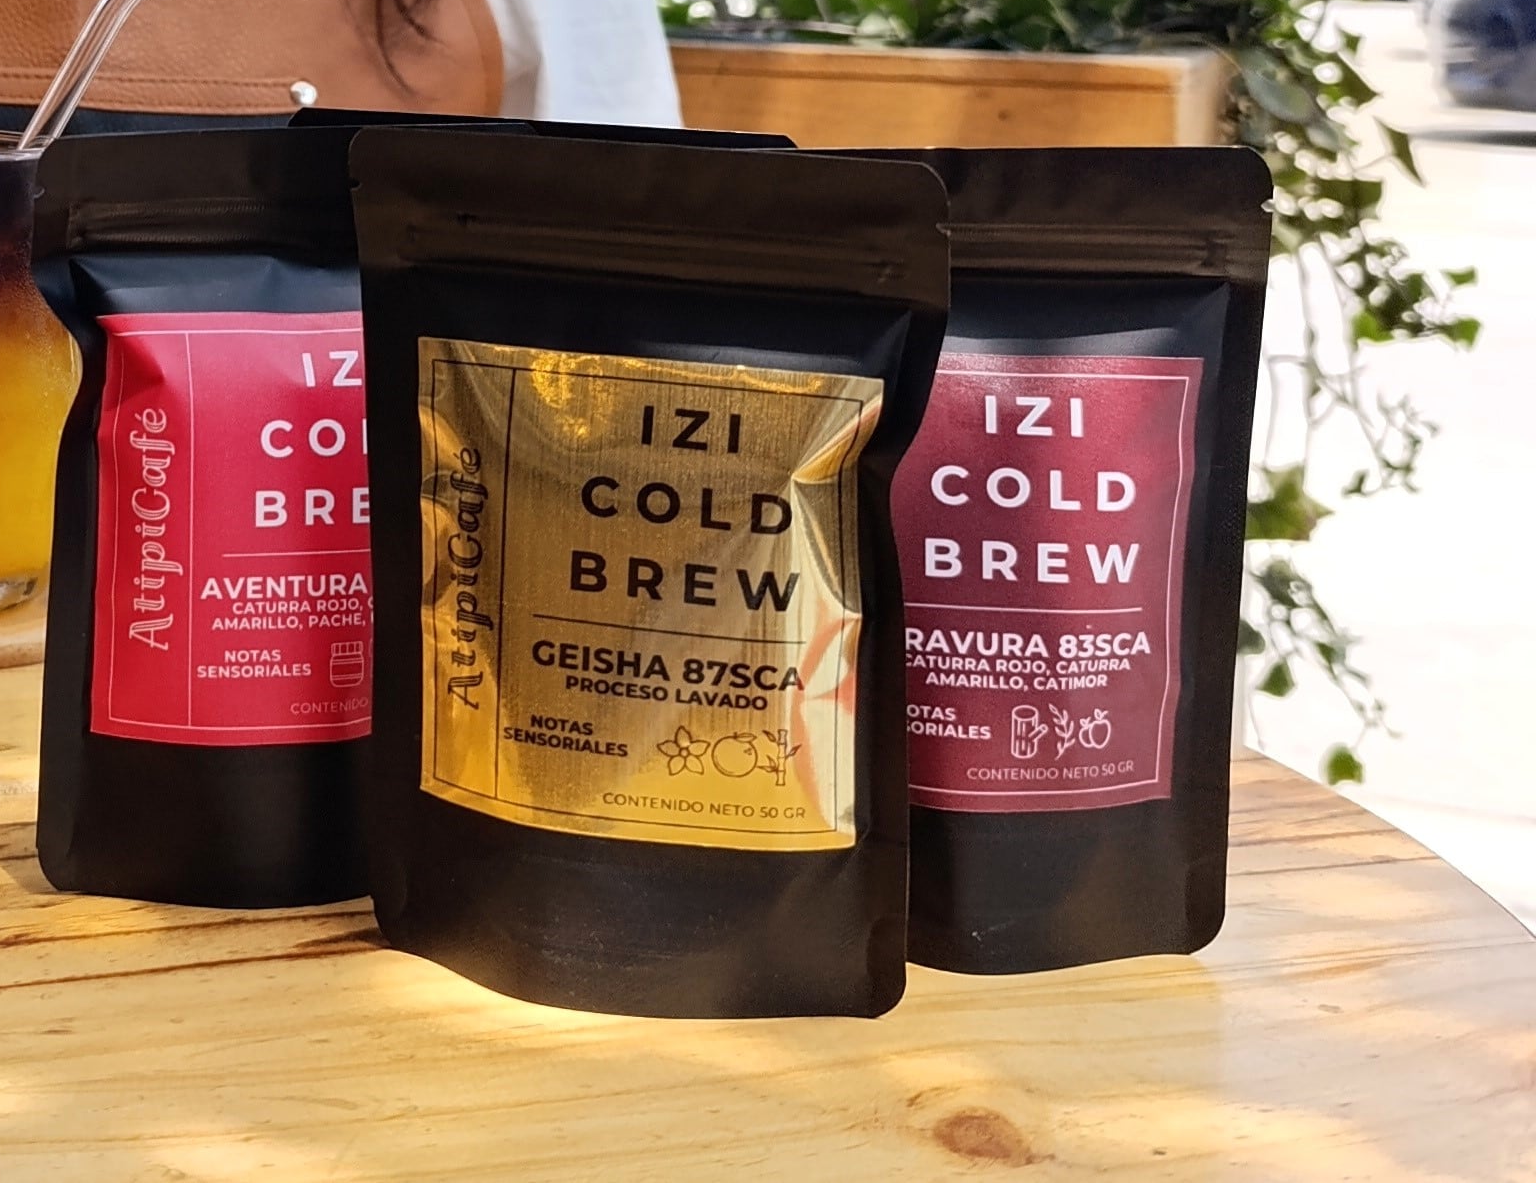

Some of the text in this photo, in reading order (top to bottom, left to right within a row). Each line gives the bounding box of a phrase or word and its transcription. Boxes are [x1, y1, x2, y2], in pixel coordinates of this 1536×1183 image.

[302, 350, 363, 387] IZ
[640, 405, 741, 454] IZI
[984, 394, 1084, 439] IZI
[261, 419, 368, 457] CO
[930, 464, 1137, 513] COLD
[255, 488, 370, 527] BRE
[581, 475, 793, 536] COLD
[129, 408, 184, 651] AtipiCafé
[923, 537, 1140, 584] BREW
[200, 572, 368, 600] AVENTURA
[447, 446, 494, 710] AtipiCafé
[570, 550, 800, 613] BREW
[212, 615, 303, 631] AMARILLO,
[308, 612, 366, 629] PACHE,
[232, 600, 312, 615] CATURRA
[316, 597, 363, 613] ROJO,
[224, 649, 282, 663] NOTAS
[905, 627, 1151, 658] RAVURA 83SCA
[196, 663, 312, 679] SENSORIALES
[531, 639, 806, 692] GEISHA 87SCA
[995, 658, 1051, 677] ROJO,
[1056, 658, 1131, 675] CATURRA
[565, 674, 769, 711] PROCESO LAVADO
[925, 671, 1109, 692] AMARILLO, CATIMOR
[290, 696, 369, 714] CONTENIDO
[906, 704, 957, 722] OTAS
[530, 714, 594, 736] NOTAS
[906, 720, 992, 740] ORIALES
[503, 726, 629, 758] SENSORIALES
[966, 760, 1134, 780] CONTENIDO NETO 50 GR
[602, 792, 806, 819] CONTENIDO NETO 50 GR
